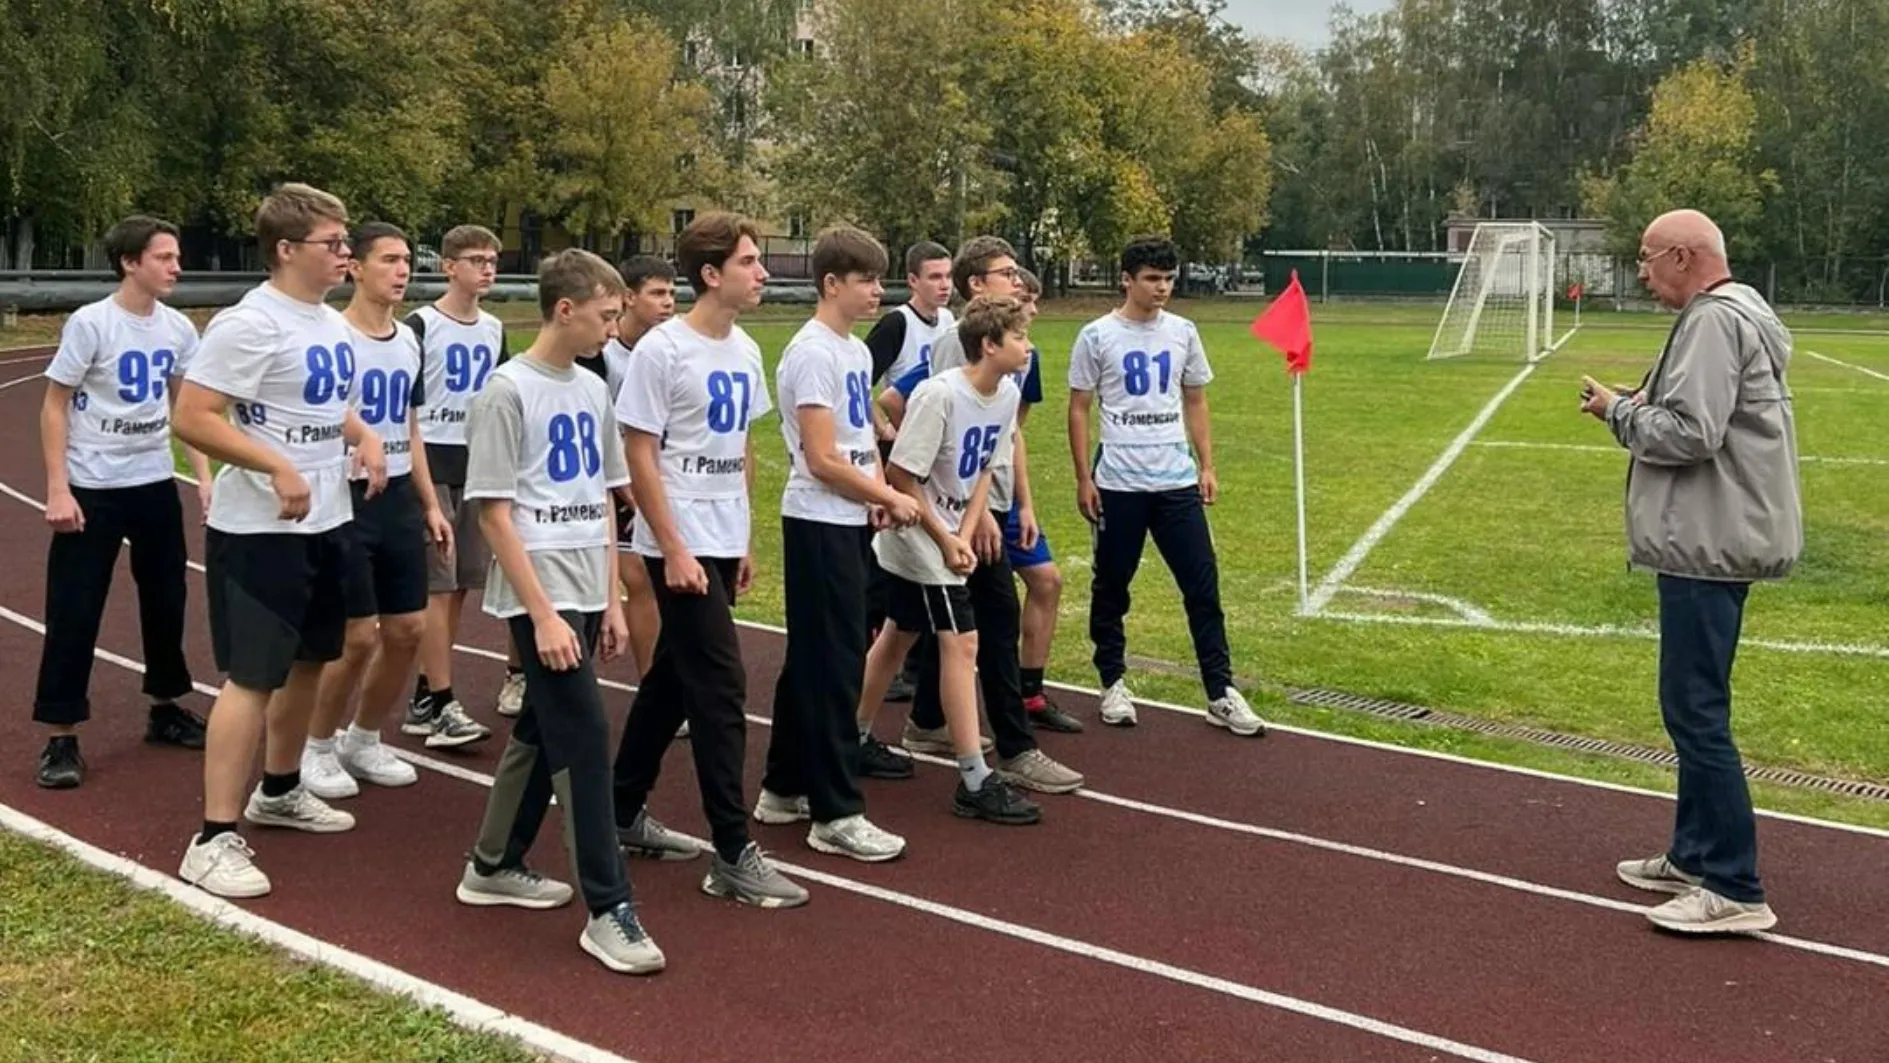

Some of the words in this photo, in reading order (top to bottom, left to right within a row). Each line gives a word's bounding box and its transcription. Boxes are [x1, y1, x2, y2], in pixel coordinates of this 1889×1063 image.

[118, 349, 174, 403] 93
[303, 341, 356, 406] 89
[445, 343, 492, 393] 92
[1122, 350, 1171, 396] 81
[235, 402, 266, 425] 89
[360, 368, 410, 426] 90
[707, 370, 750, 433] 87
[547, 411, 600, 482] 88
[958, 424, 1001, 480] 85
